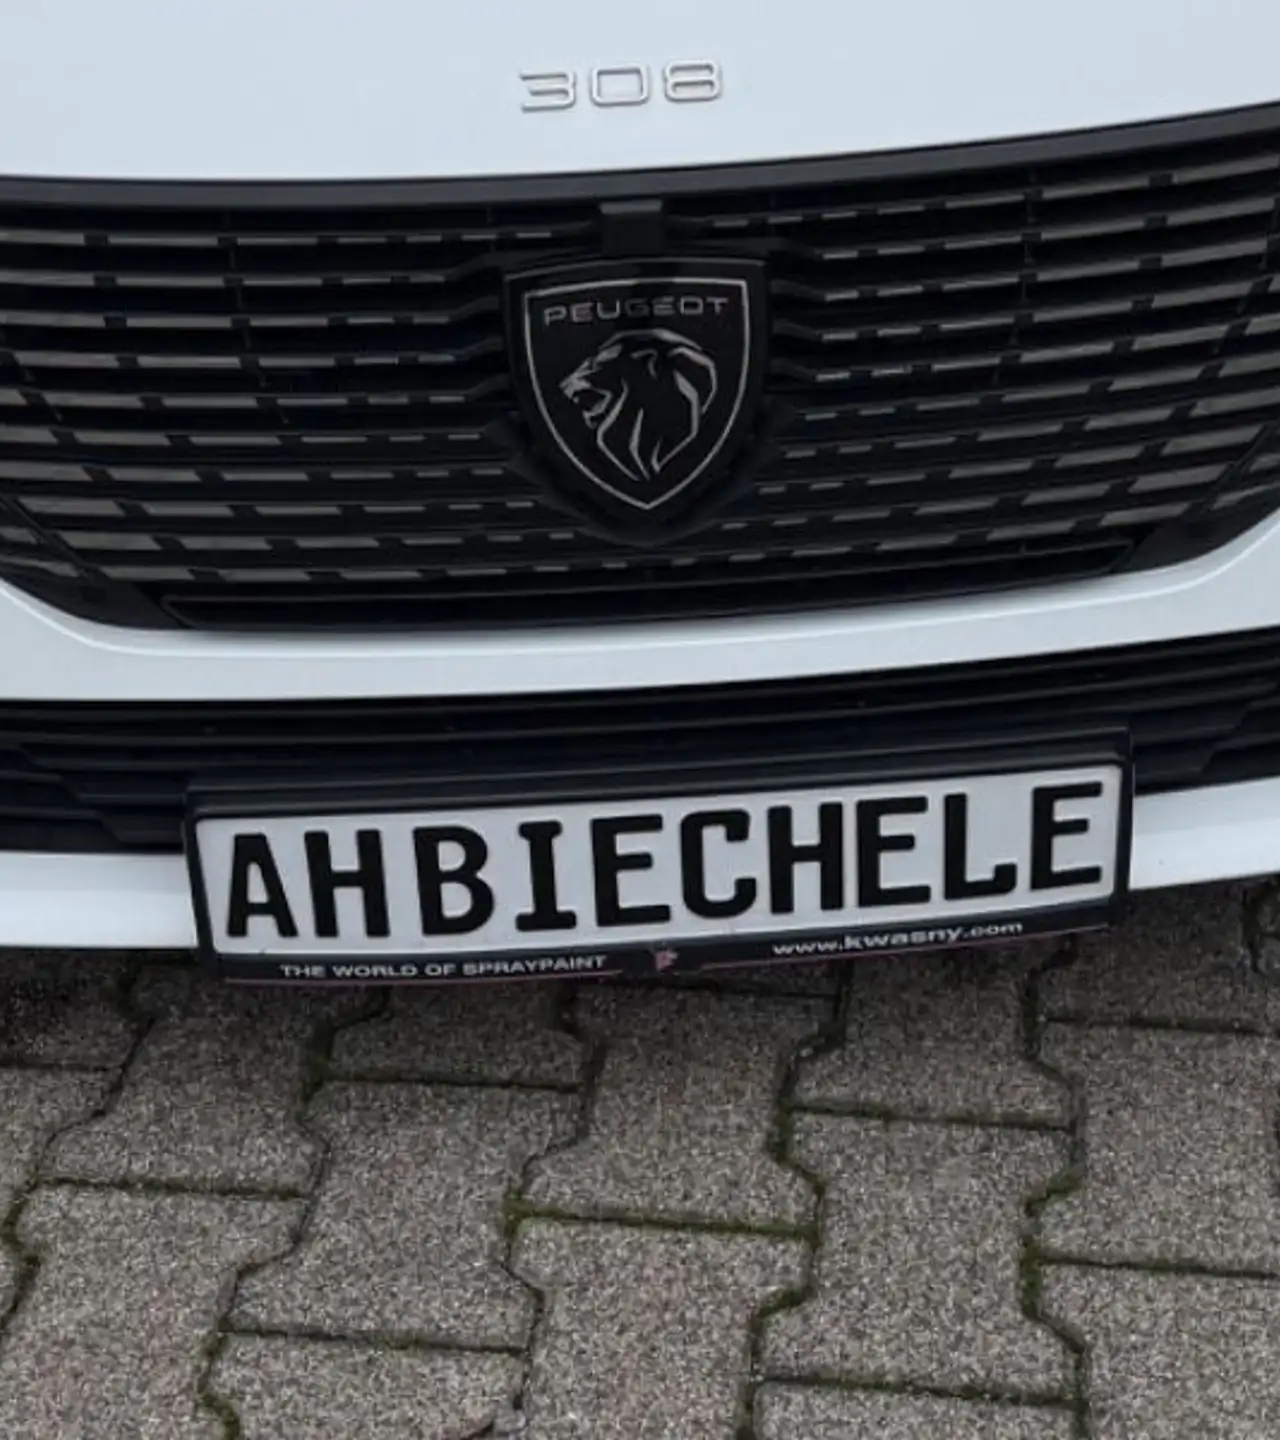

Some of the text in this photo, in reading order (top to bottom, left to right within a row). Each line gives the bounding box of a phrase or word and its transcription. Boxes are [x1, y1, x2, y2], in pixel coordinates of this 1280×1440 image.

[520, 61, 722, 112] 308
[543, 295, 730, 327] PEUGEOT
[226, 780, 1104, 939] AHBIECHELE
[771, 921, 1024, 957] www.kwasny.com
[280, 954, 607, 978] THE WORLD OF SPRAYPAINT
